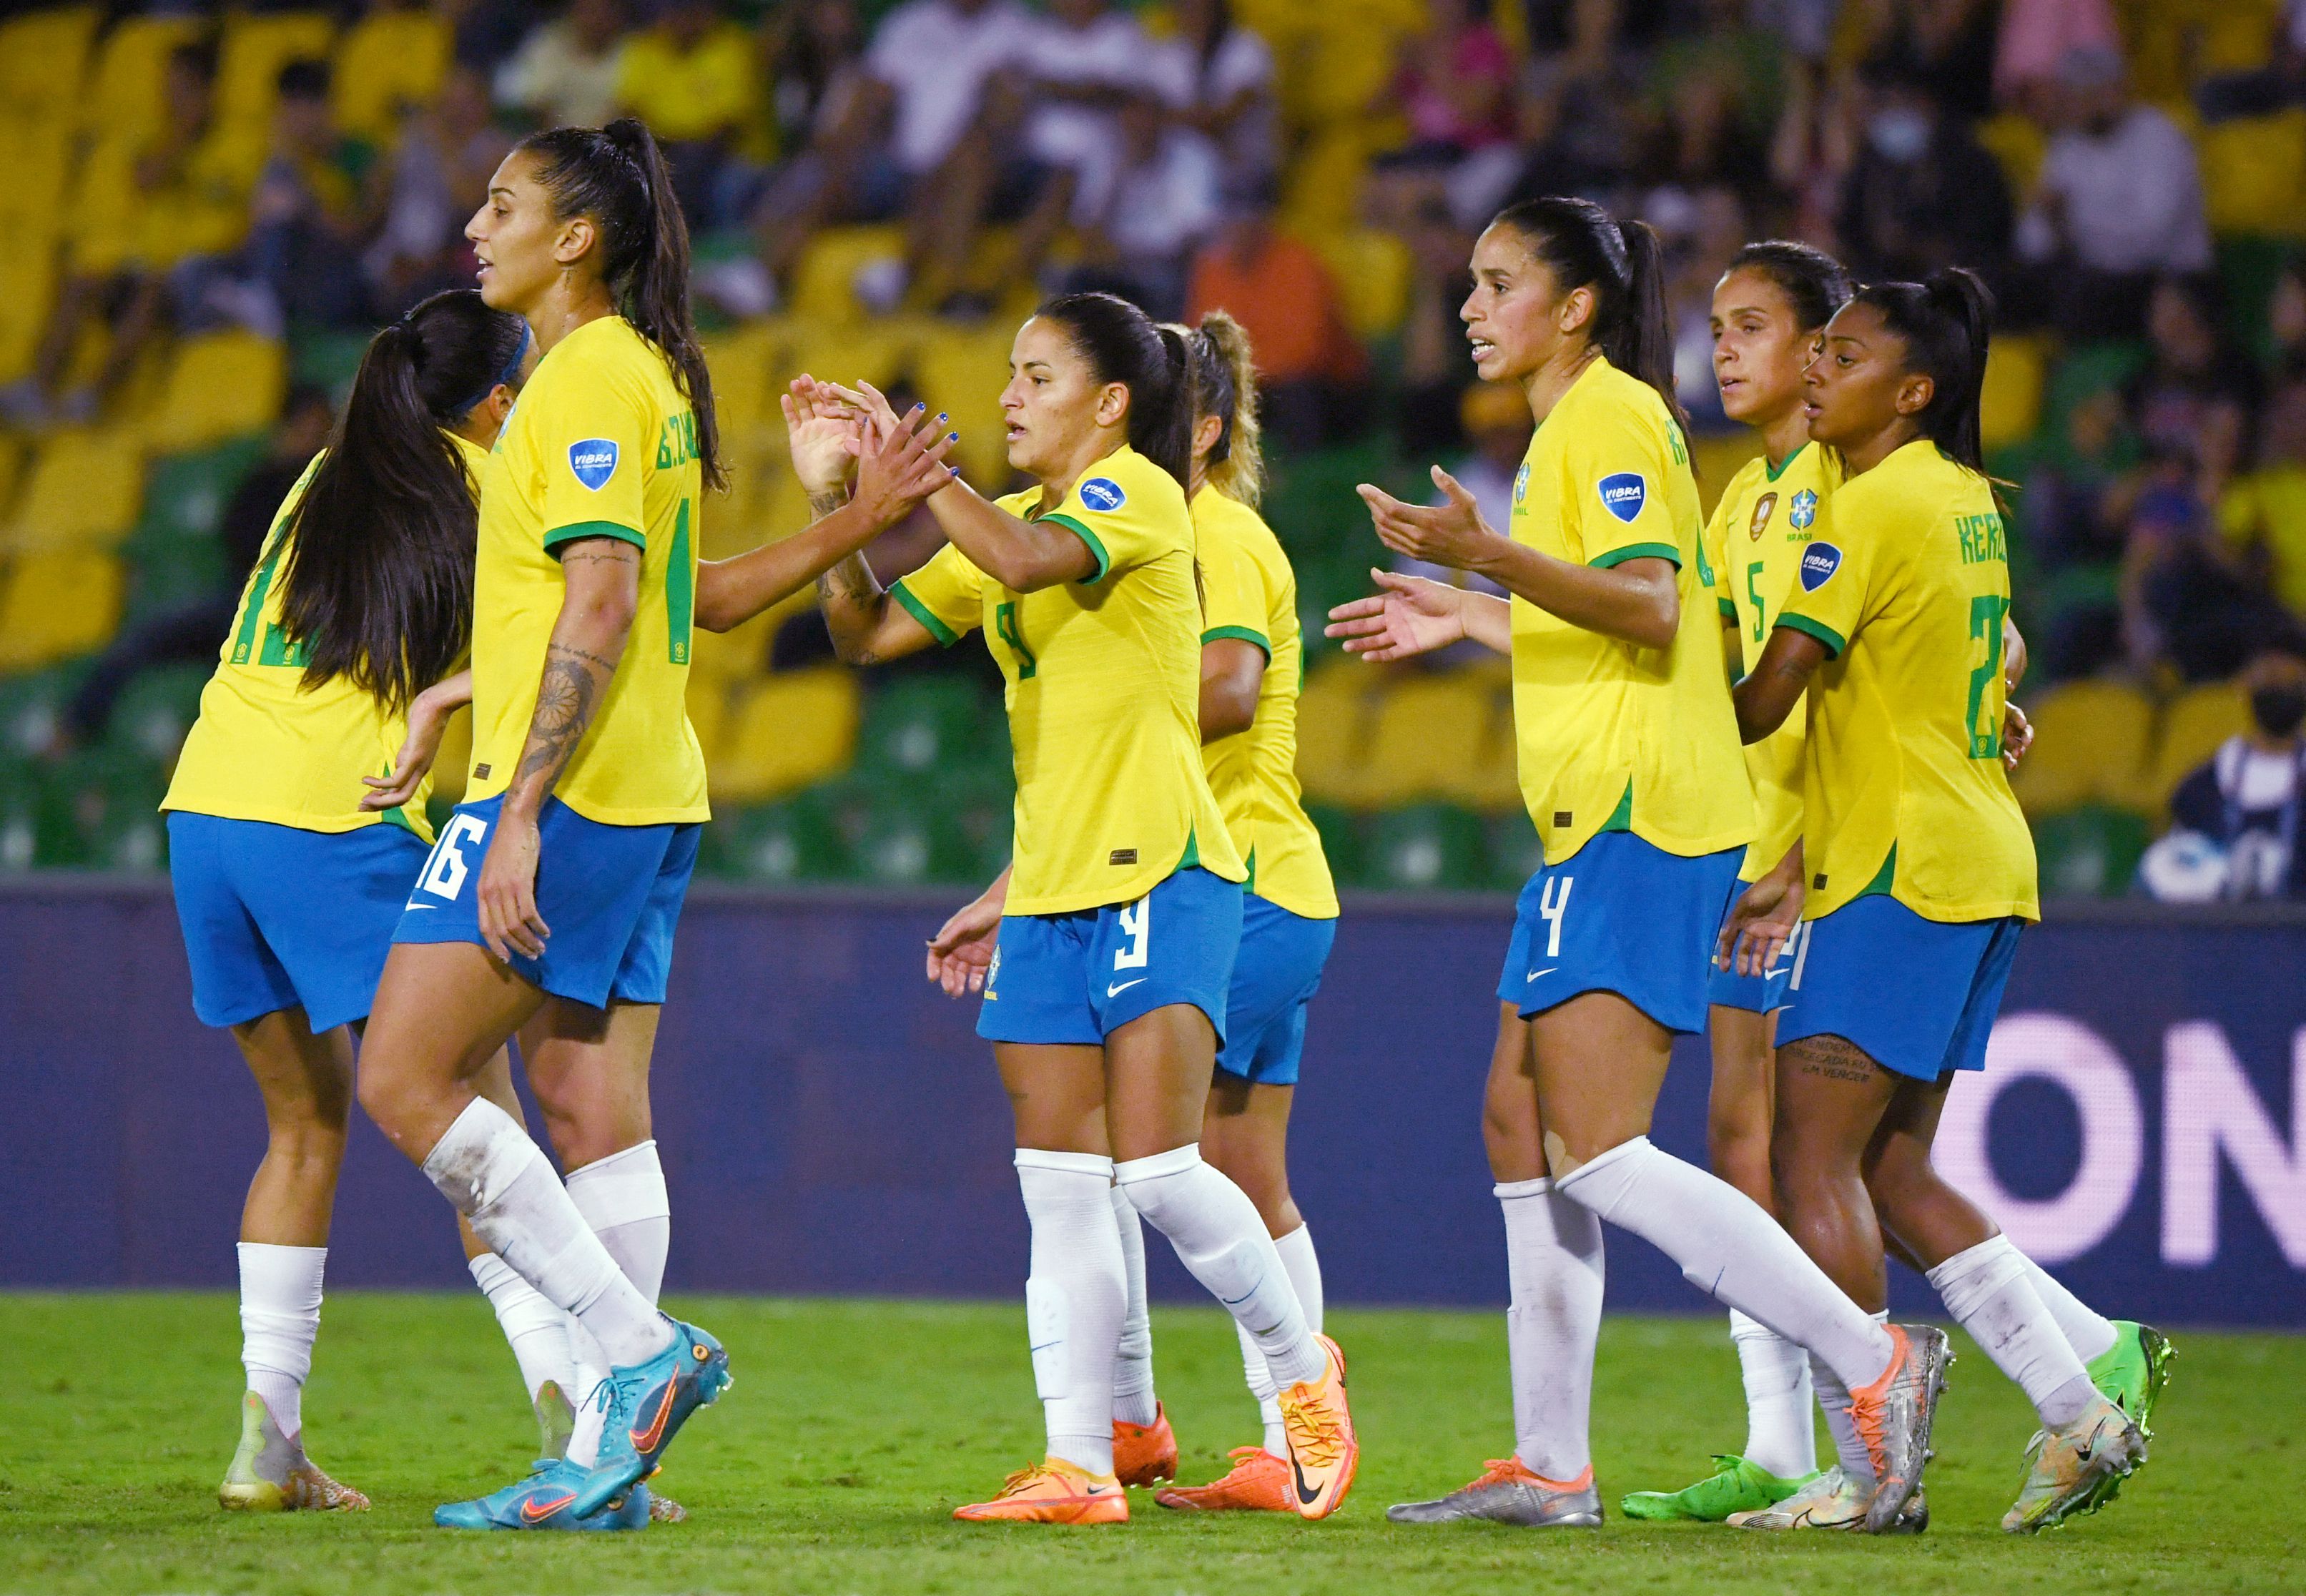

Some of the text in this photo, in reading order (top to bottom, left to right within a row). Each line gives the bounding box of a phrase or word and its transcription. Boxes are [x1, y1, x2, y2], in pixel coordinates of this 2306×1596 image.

[574, 453, 612, 465] VIBRA
[1084, 483, 1119, 505] VIBRA
[1605, 486, 1641, 499] VIBRA
[1747, 560, 1765, 643] 5
[1804, 555, 1835, 570] VIBRA
[996, 601, 1036, 681] 9
[1113, 892, 1150, 972] 9
[1539, 875, 1574, 957] 4
[1928, 1008, 2306, 1270] ON
